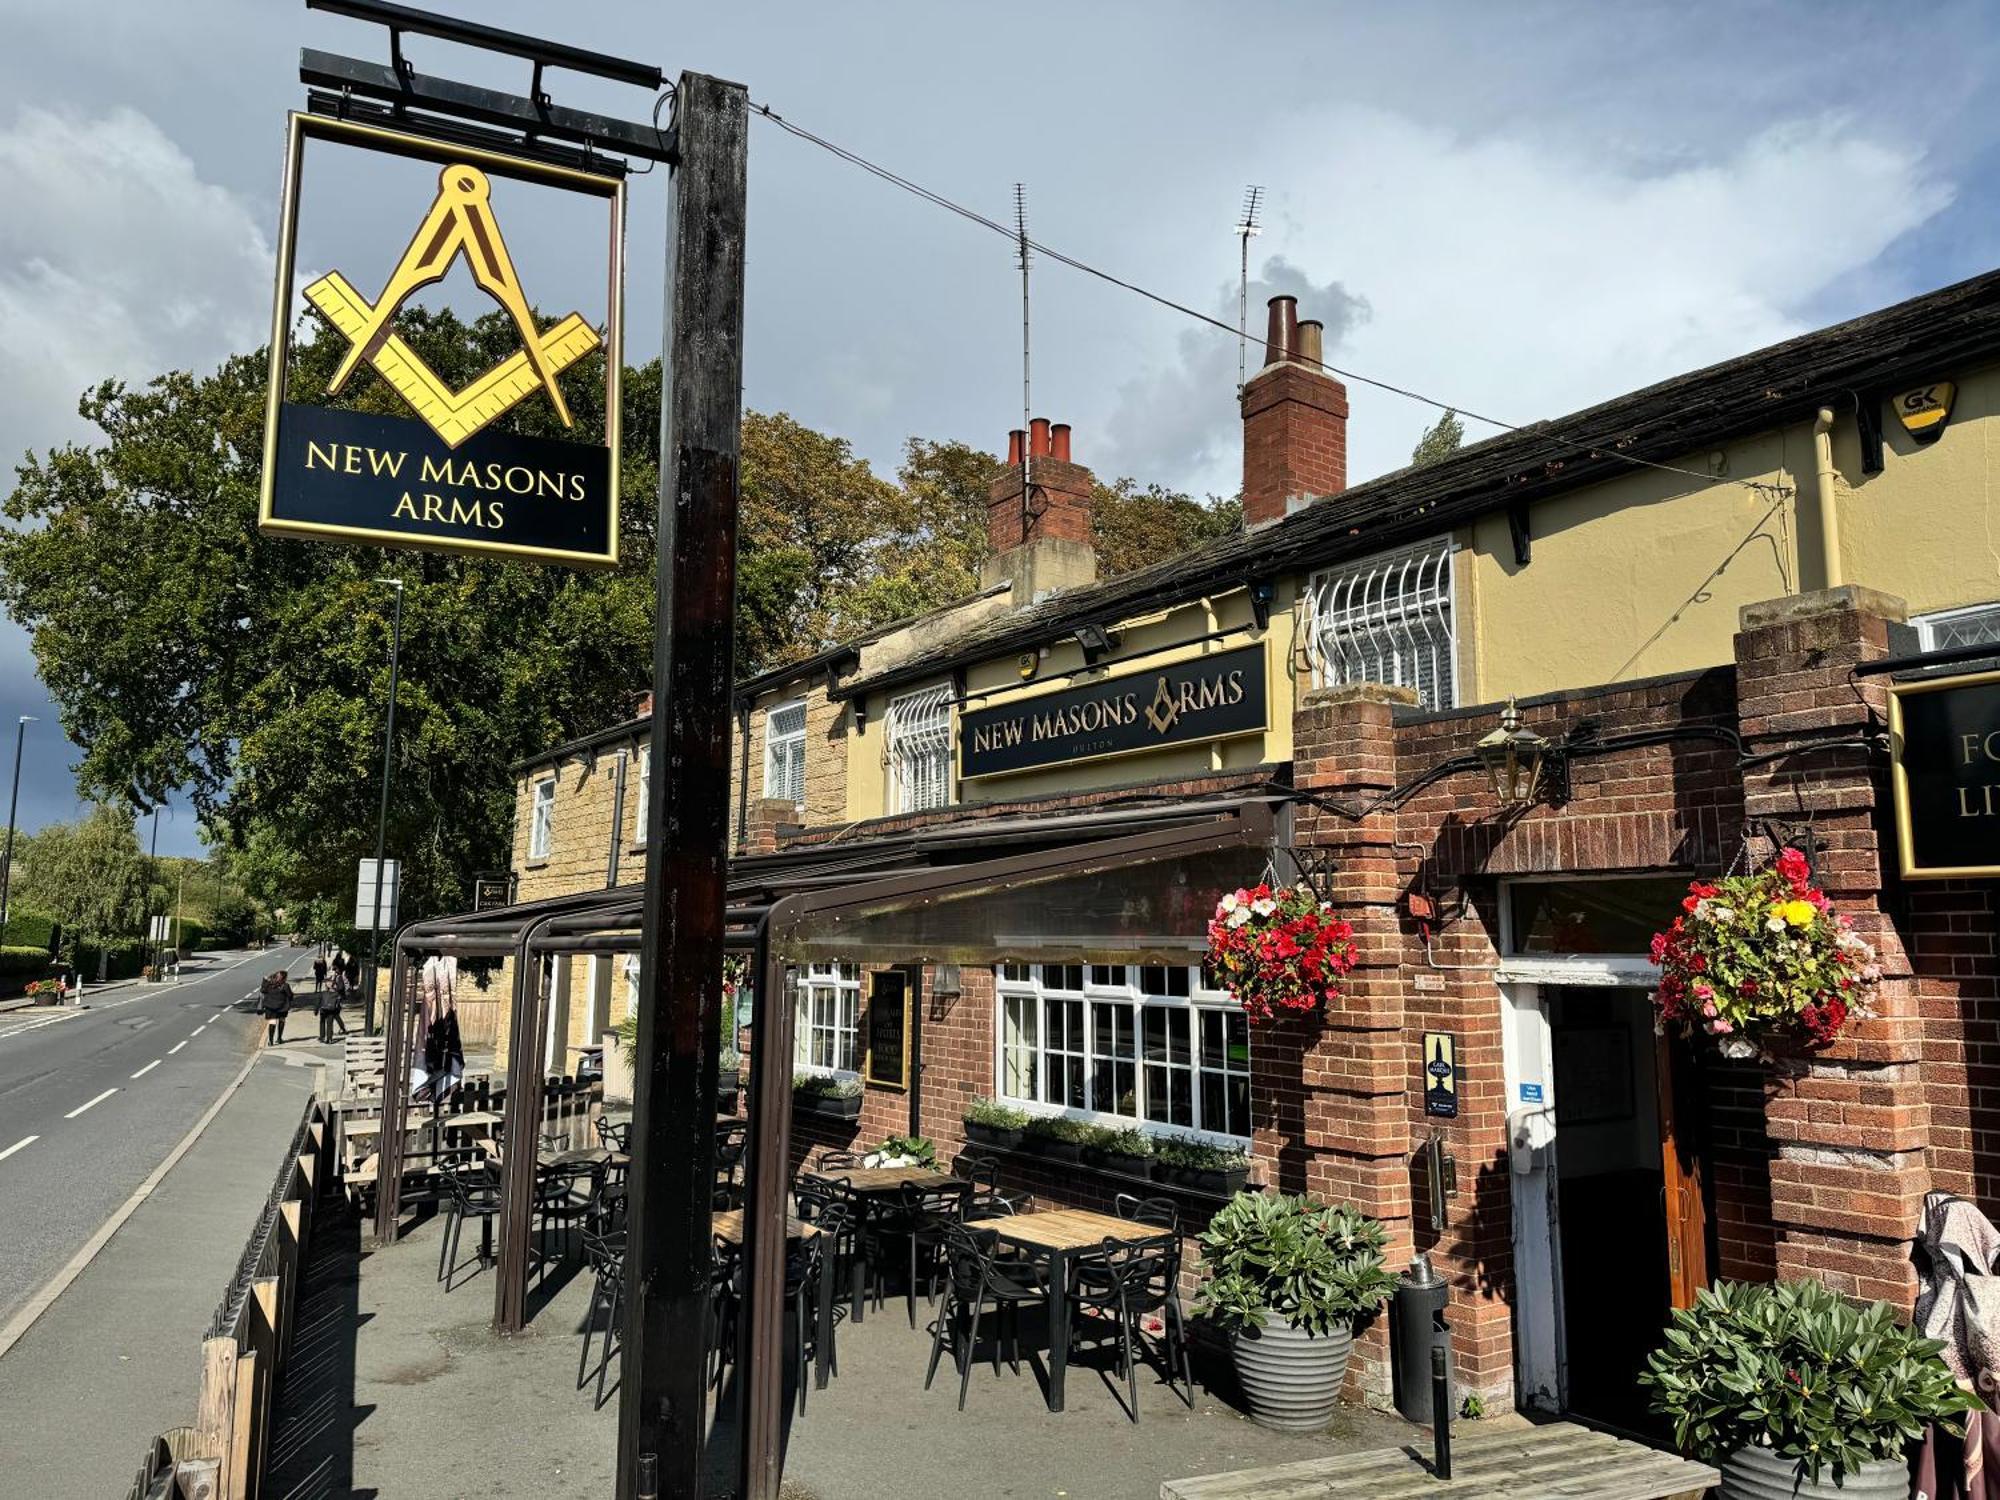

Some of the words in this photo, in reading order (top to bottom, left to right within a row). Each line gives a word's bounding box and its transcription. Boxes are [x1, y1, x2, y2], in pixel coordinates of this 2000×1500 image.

[1904, 386, 1938, 410] GK
[304, 440, 408, 479] NEW
[419, 455, 586, 501] MASONS
[391, 491, 505, 530] ARMS
[974, 715, 1024, 754] NEW
[1031, 692, 1138, 742] MASONS
